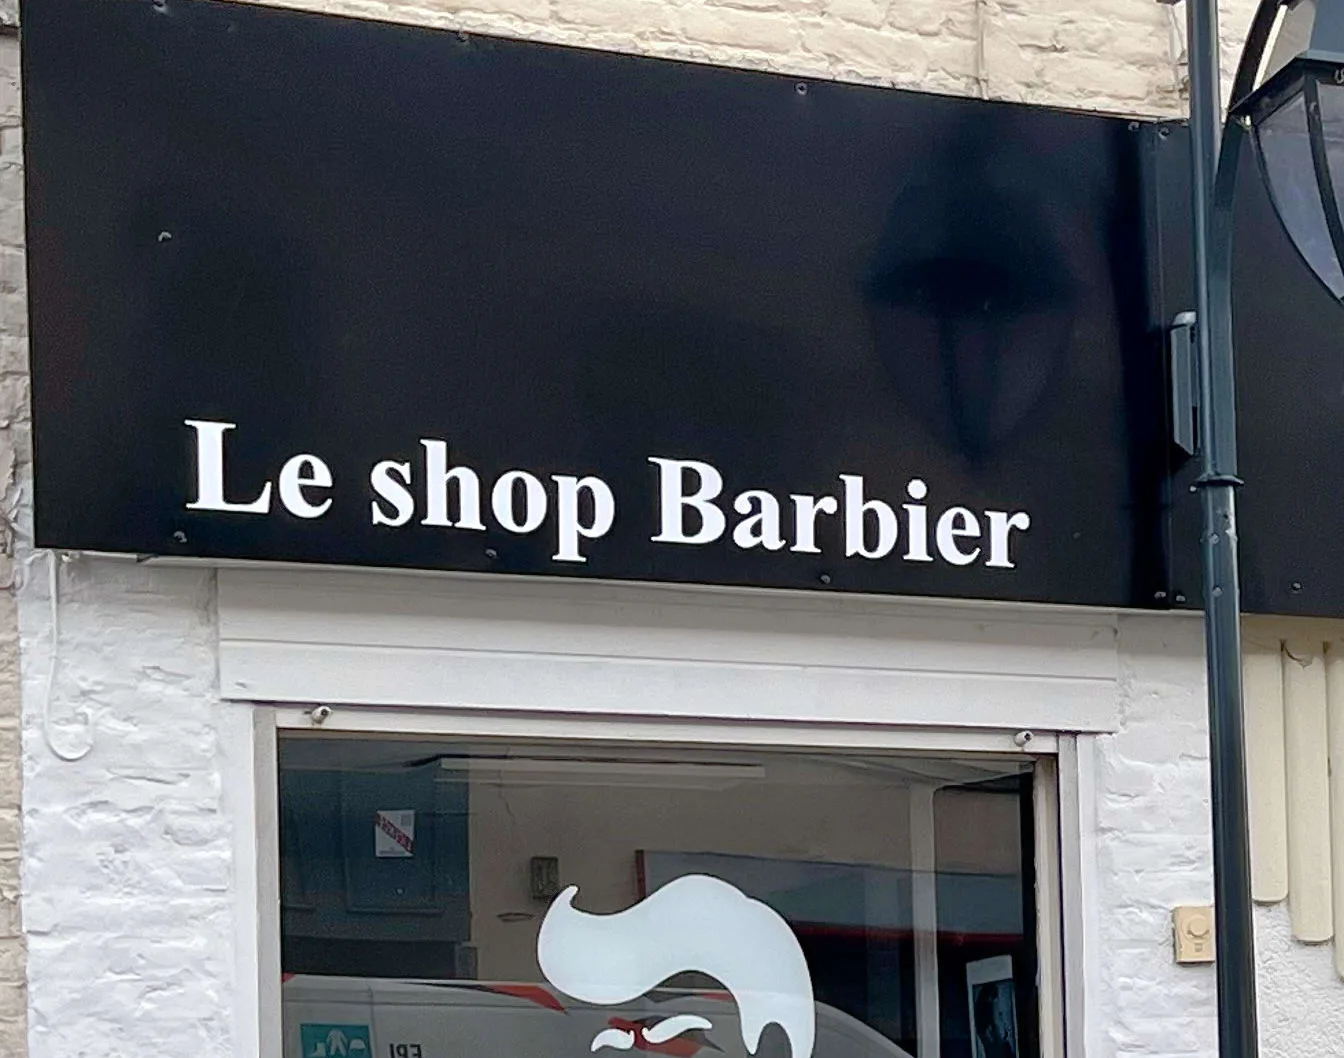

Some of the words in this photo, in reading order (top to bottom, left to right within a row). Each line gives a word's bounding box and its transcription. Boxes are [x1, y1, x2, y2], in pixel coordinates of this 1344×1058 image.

[185, 419, 333, 518] Le
[370, 439, 616, 562] shop
[647, 456, 1030, 568] Barbier
